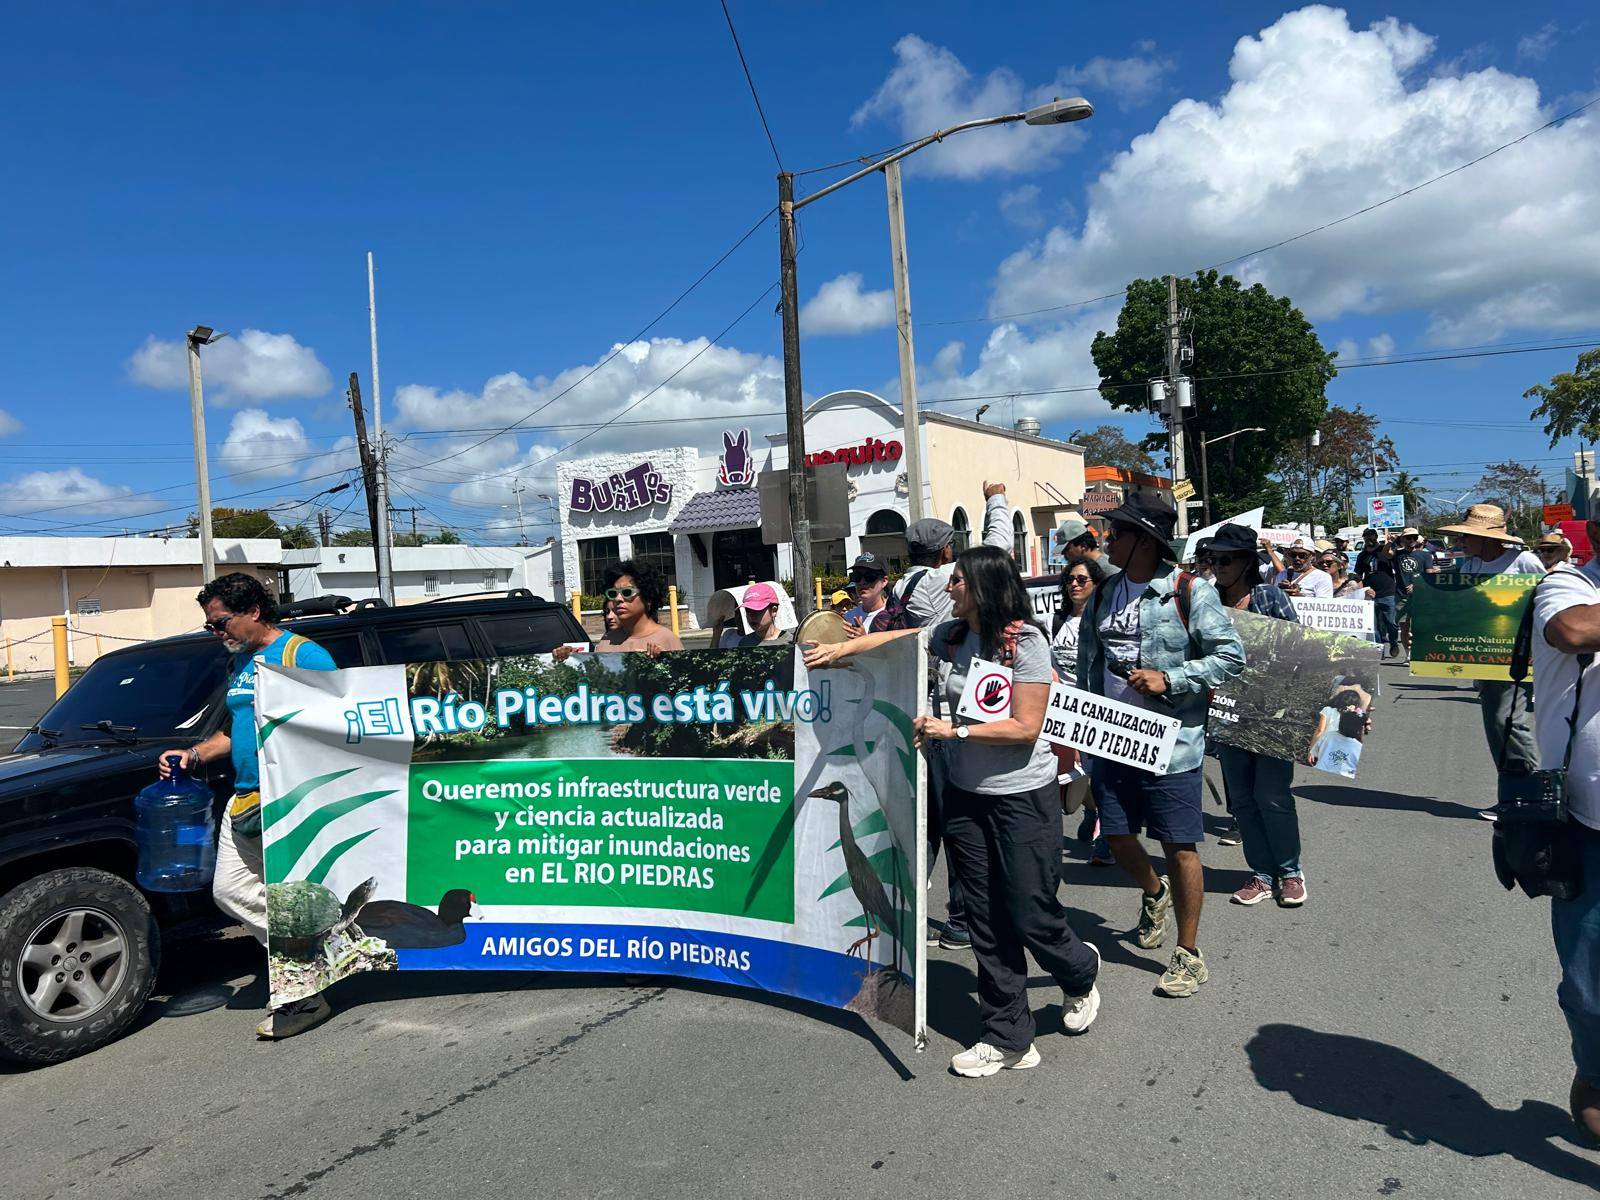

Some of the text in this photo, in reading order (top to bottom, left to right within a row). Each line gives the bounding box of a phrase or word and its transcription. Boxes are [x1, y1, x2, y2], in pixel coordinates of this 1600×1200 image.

[1372, 500, 1384, 509] NO
[1297, 601, 1364, 614] CANALIZACIÓN
[1317, 615, 1364, 629] PIEDRAS
[1434, 634, 1515, 645] Corazón Natural
[344, 679, 832, 744] ¡El Río Piedras está vivo!
[1051, 692, 1167, 740] A LA CANALIZACIÓN
[1042, 717, 1161, 767] DEL RÍO PIEDRAS
[422, 776, 781, 803] Queremos infraestructura verde
[495, 806, 724, 831] y ciencia actualizada
[455, 834, 751, 862] para mitigar inundaciones
[505, 862, 714, 890] en EL RIO PIEDRAS
[481, 935, 751, 971] AMIGOS DEL RÍO PIEDRAS
